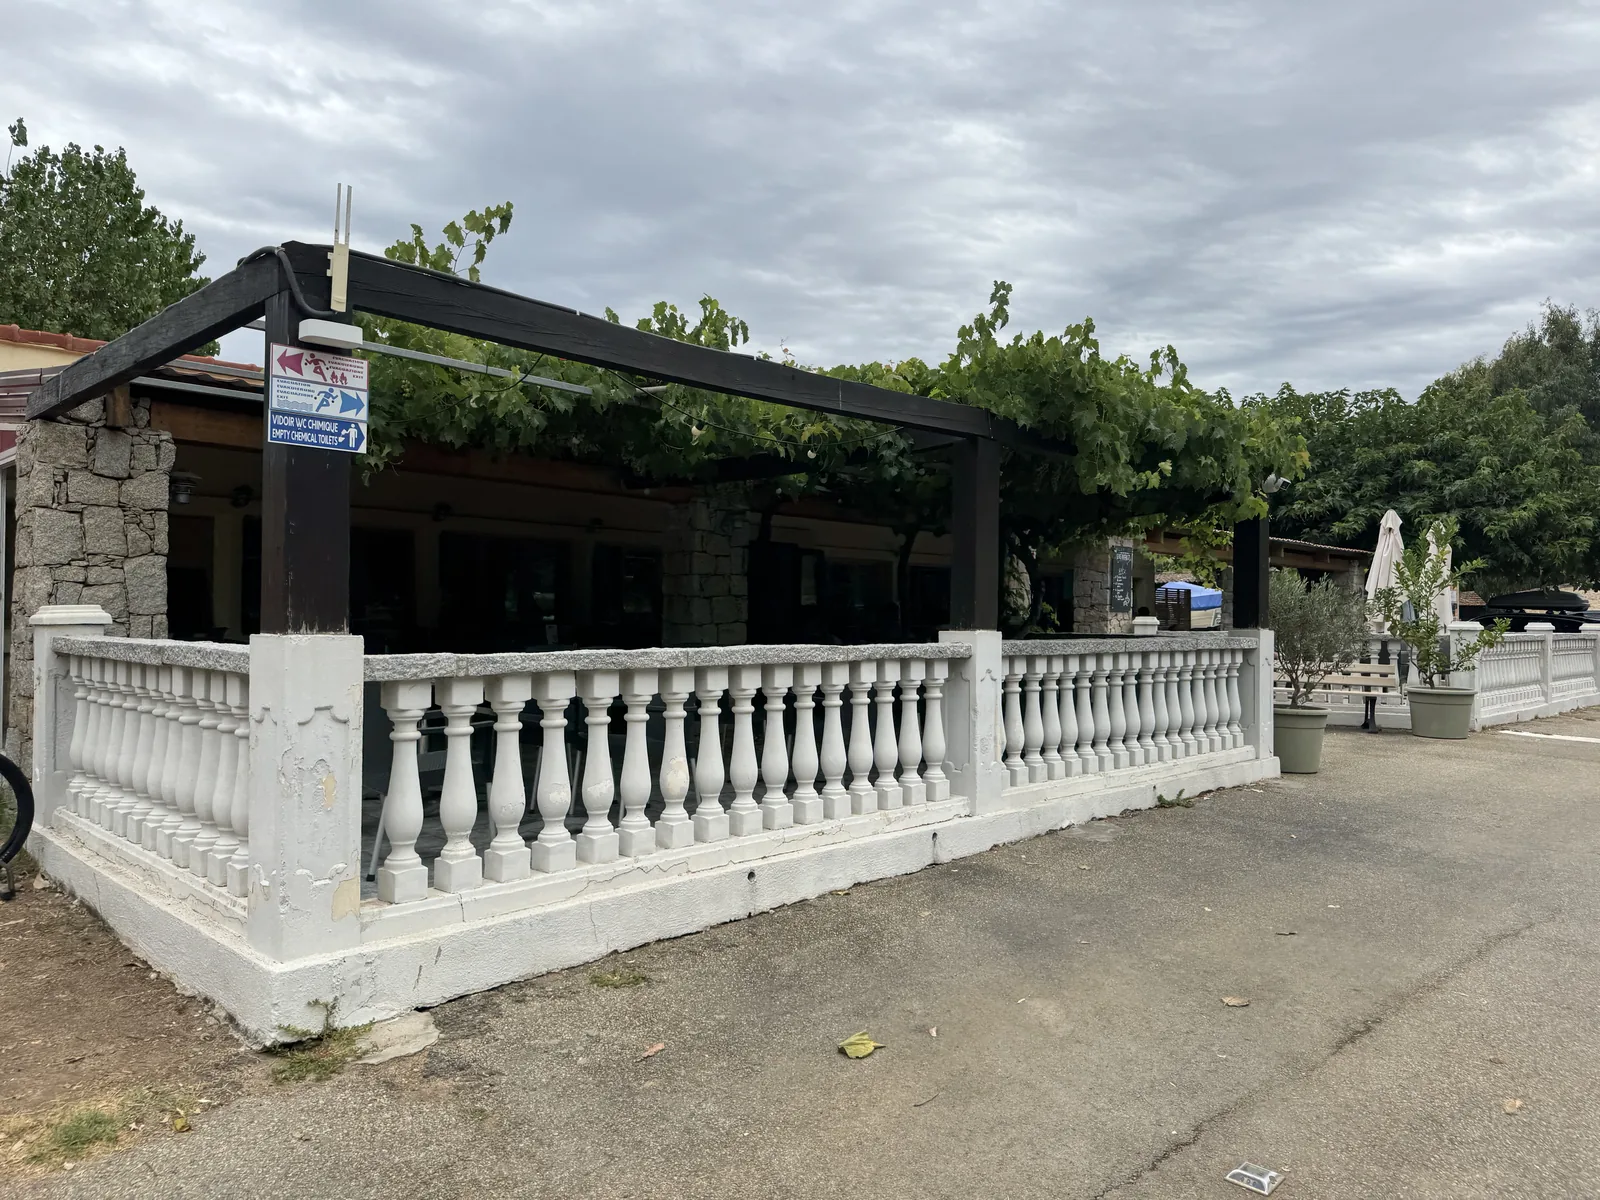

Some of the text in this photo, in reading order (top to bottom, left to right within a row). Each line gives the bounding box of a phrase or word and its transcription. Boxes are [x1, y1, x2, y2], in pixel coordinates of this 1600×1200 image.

[332, 356, 364, 364] EVACUATION
[328, 360, 364, 369] EVAKUIERUNG
[329, 366, 364, 374] EVACUAZIONE
[276, 379, 310, 387] EVACUATION
[276, 384, 315, 393] EVAKUIERUNG
[276, 390, 314, 398] EVACUAZIONE
[272, 414, 338, 433] VIDOIR WC CHIMIQUE
[272, 428, 338, 446] EMPTY CHEMICAL TOILETS
